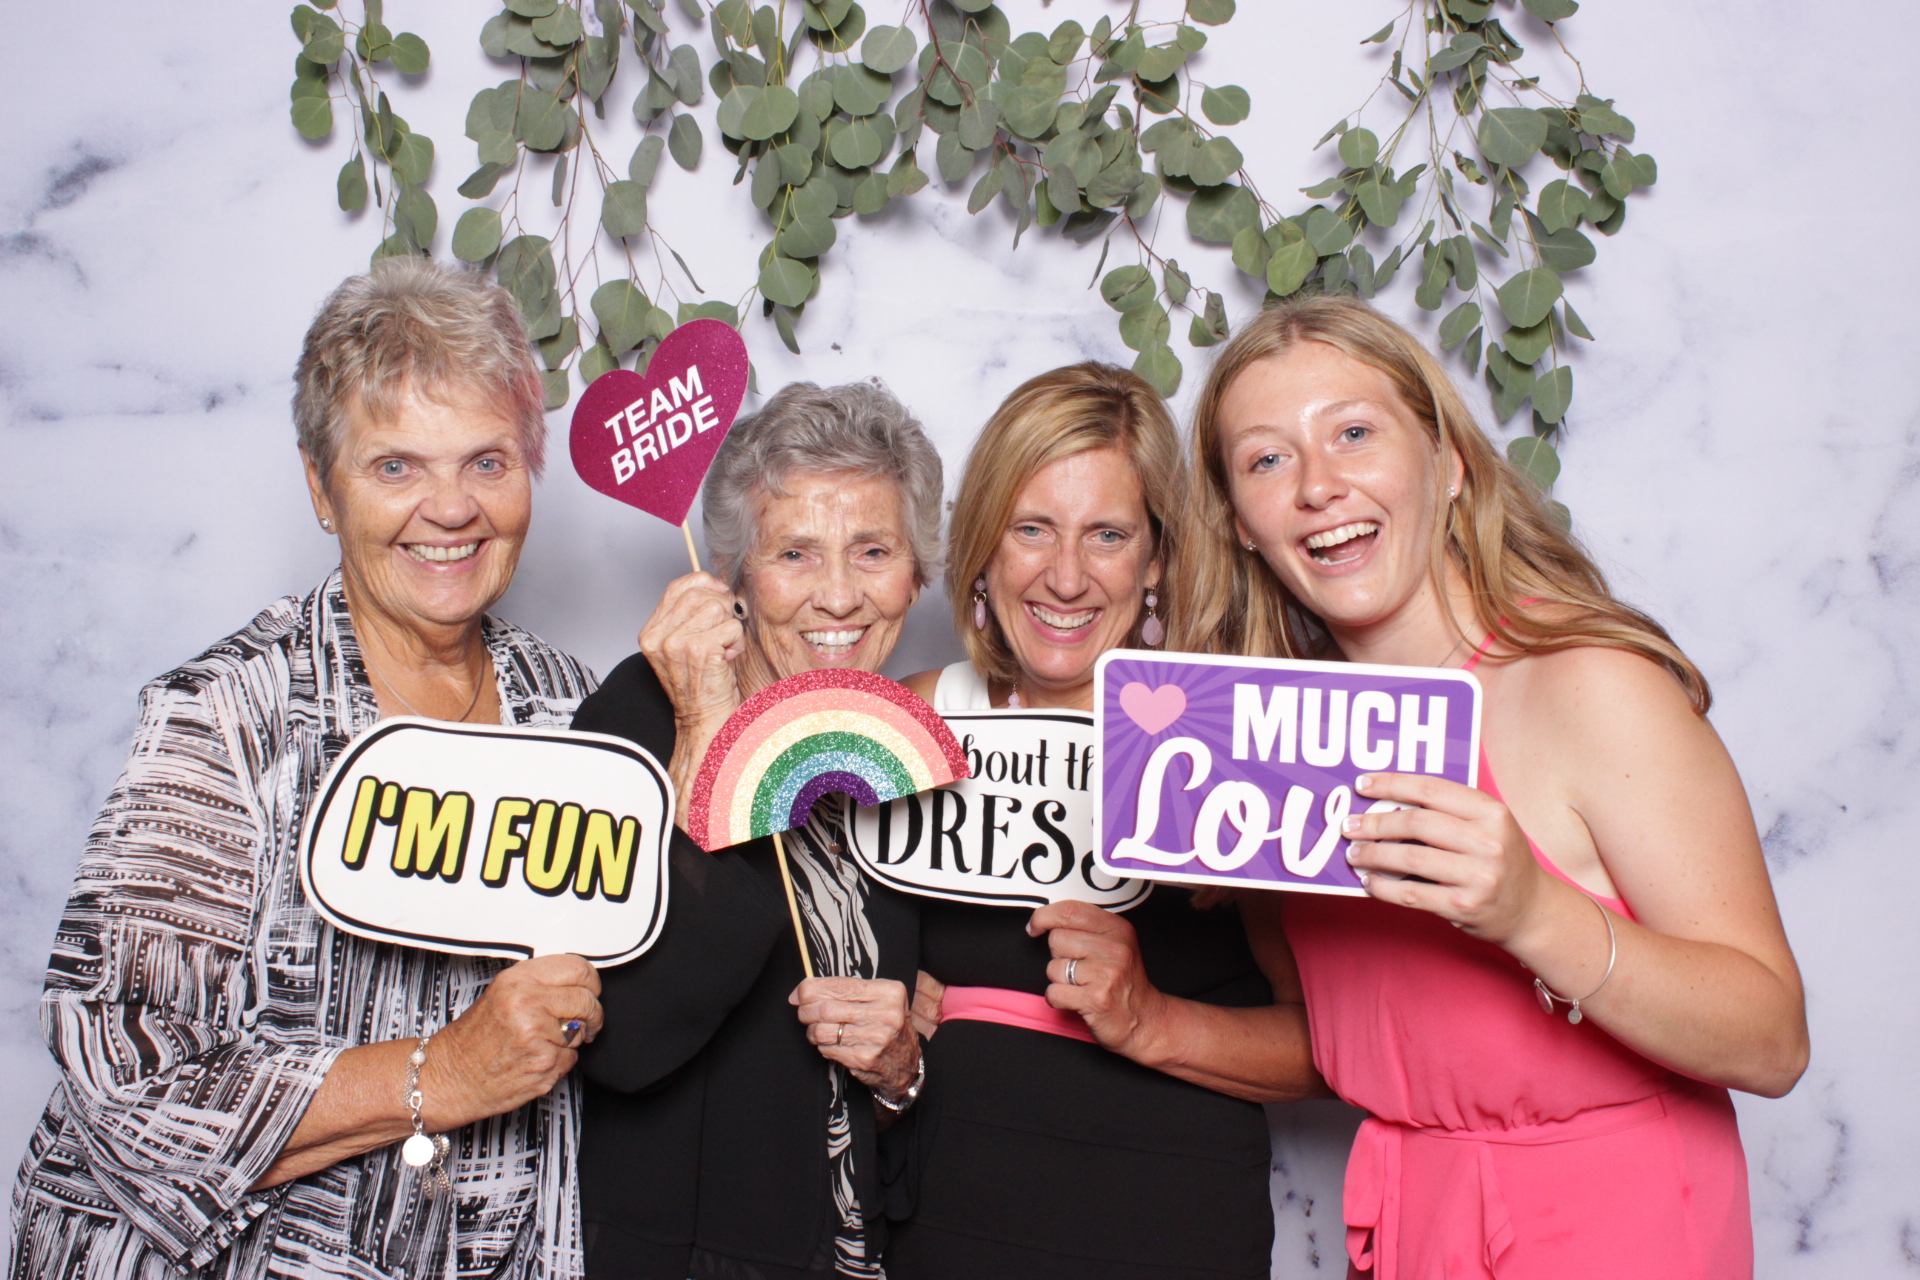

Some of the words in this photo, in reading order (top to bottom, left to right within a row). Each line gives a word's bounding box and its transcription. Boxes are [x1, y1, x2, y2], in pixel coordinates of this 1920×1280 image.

[604, 364, 704, 446] TEAM
[610, 394, 720, 486] BRIDE
[962, 733, 1050, 787] bout
[1232, 683, 1448, 774] MUCH
[341, 775, 475, 883] I'M
[480, 796, 642, 903] FUN
